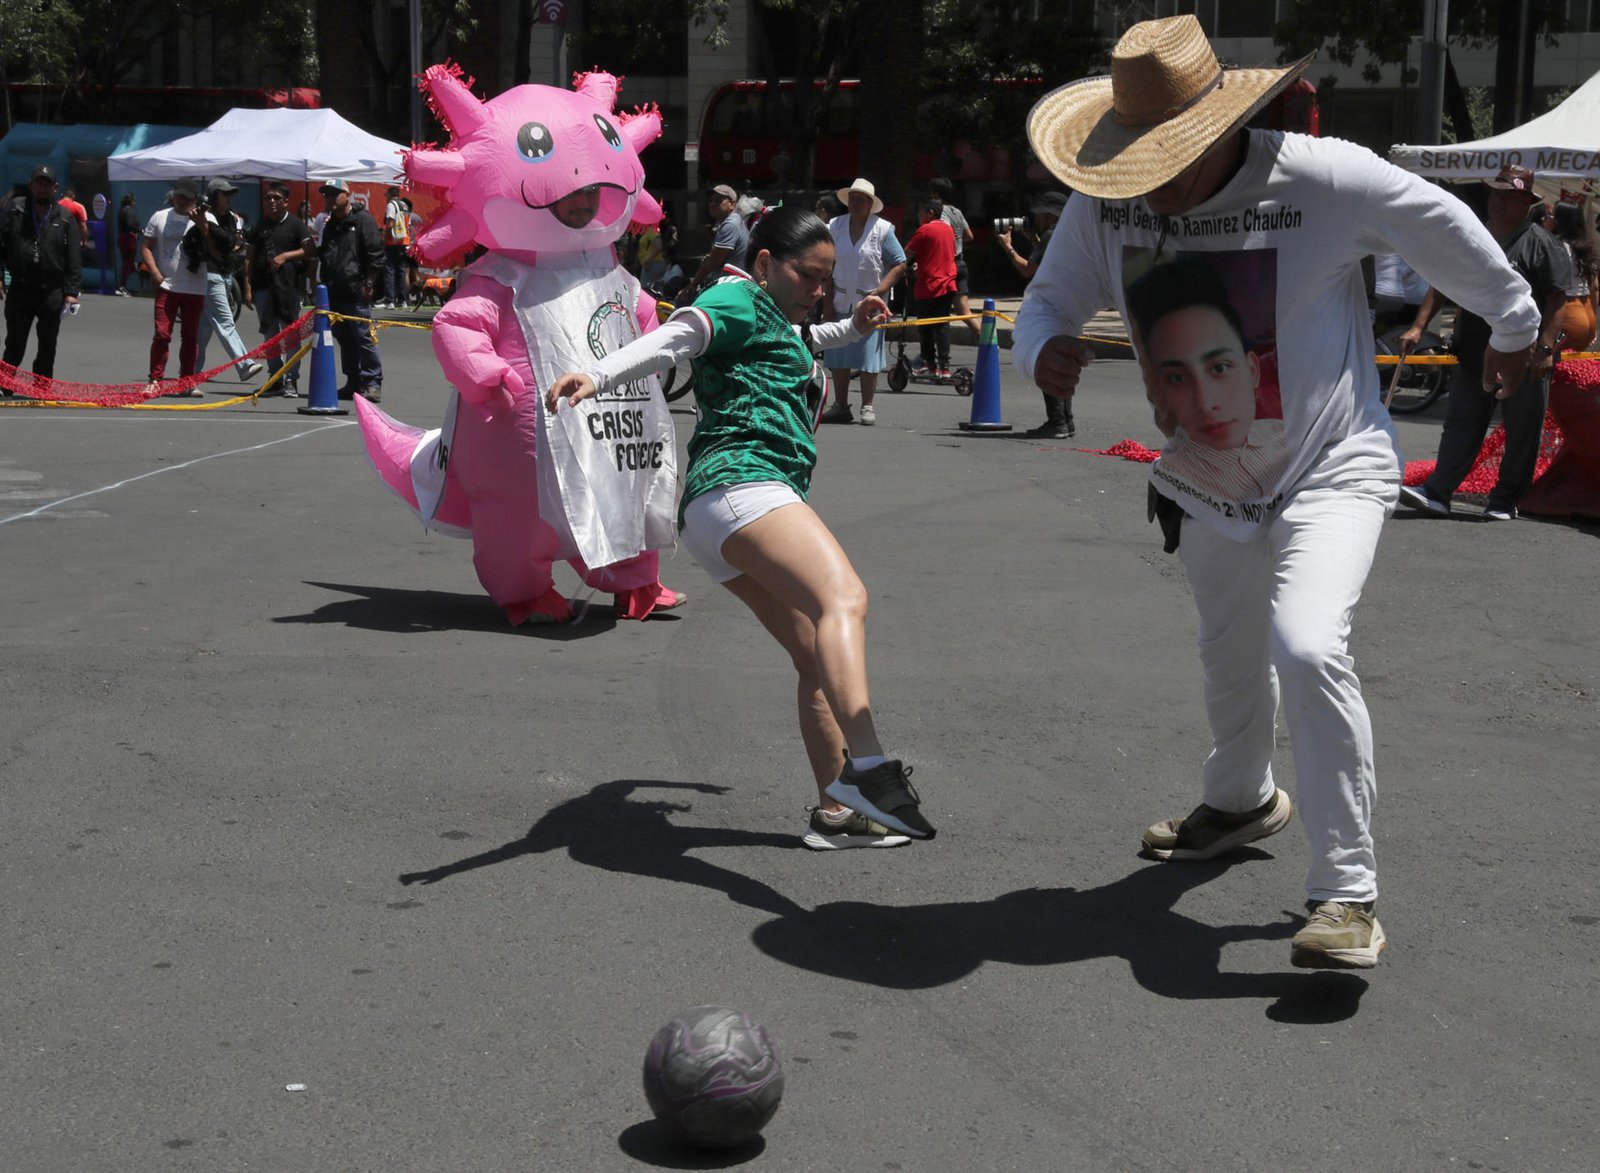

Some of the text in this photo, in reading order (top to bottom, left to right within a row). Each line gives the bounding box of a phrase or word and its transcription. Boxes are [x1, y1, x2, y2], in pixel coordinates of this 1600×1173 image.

[1420, 151, 1522, 170] SERVICIO
[1134, 204, 1179, 236] Geraro
[1183, 211, 1238, 237] Ramírez
[1243, 205, 1302, 232] Chaufón
[587, 409, 644, 441] CRISIS
